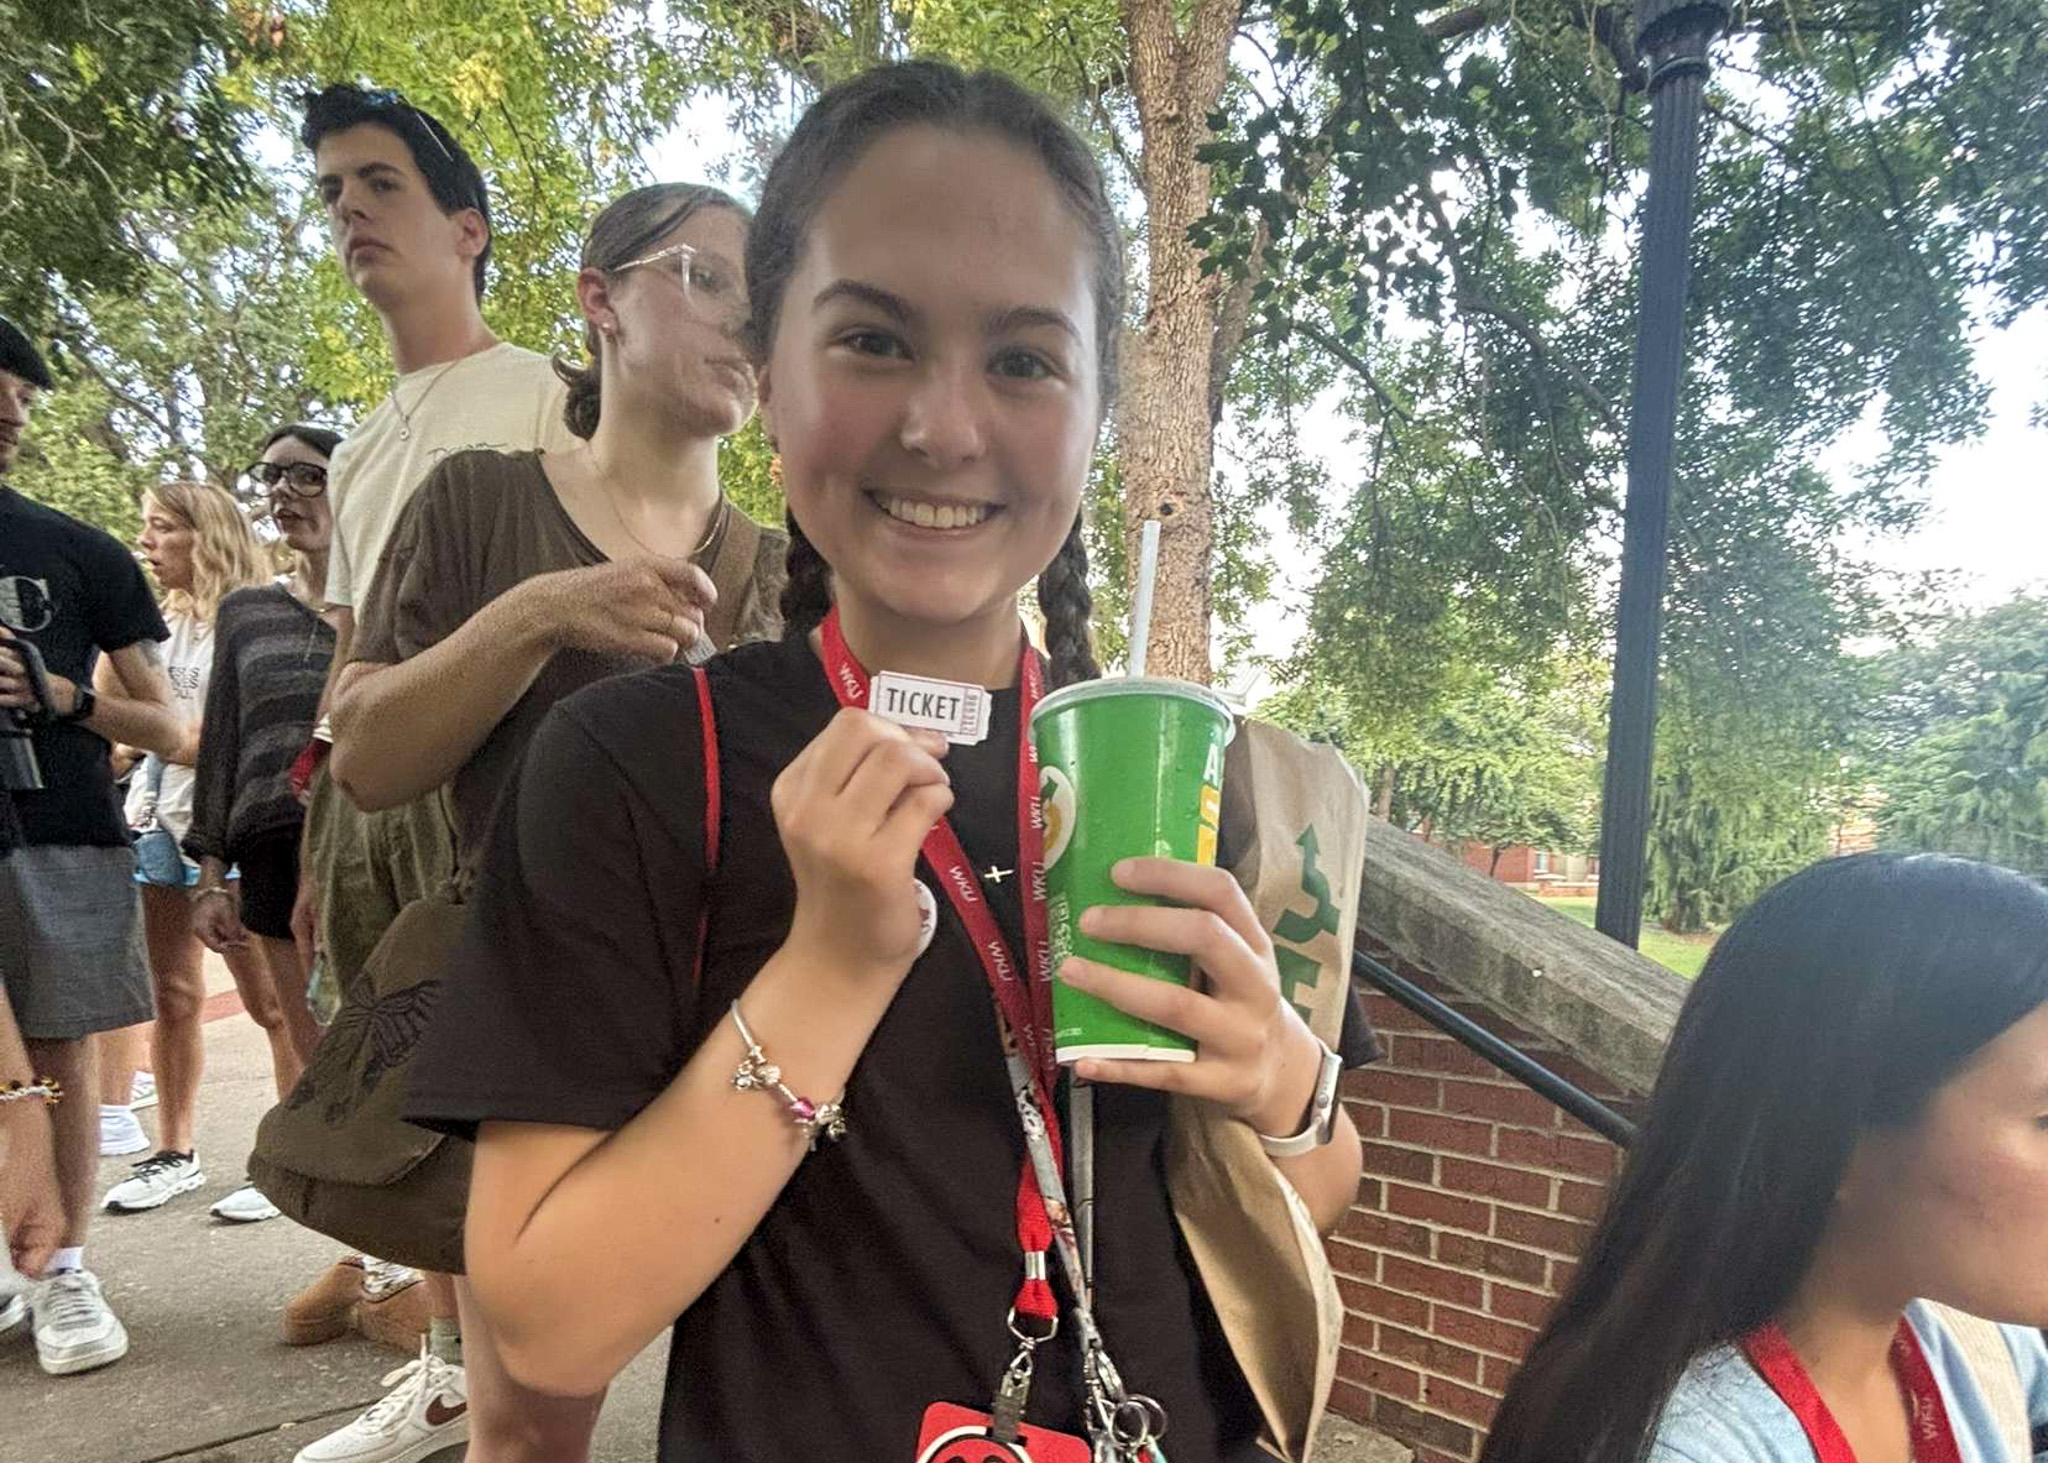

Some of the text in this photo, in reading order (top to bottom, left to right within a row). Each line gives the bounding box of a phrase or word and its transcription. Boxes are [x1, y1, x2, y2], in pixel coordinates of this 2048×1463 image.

[840, 662, 864, 700] WKU
[886, 687, 961, 721] TICKET
[950, 865, 978, 902] WKU
[1032, 861, 1047, 901] WKU
[988, 941, 1014, 982] WKU
[1039, 940, 1051, 982] WKU
